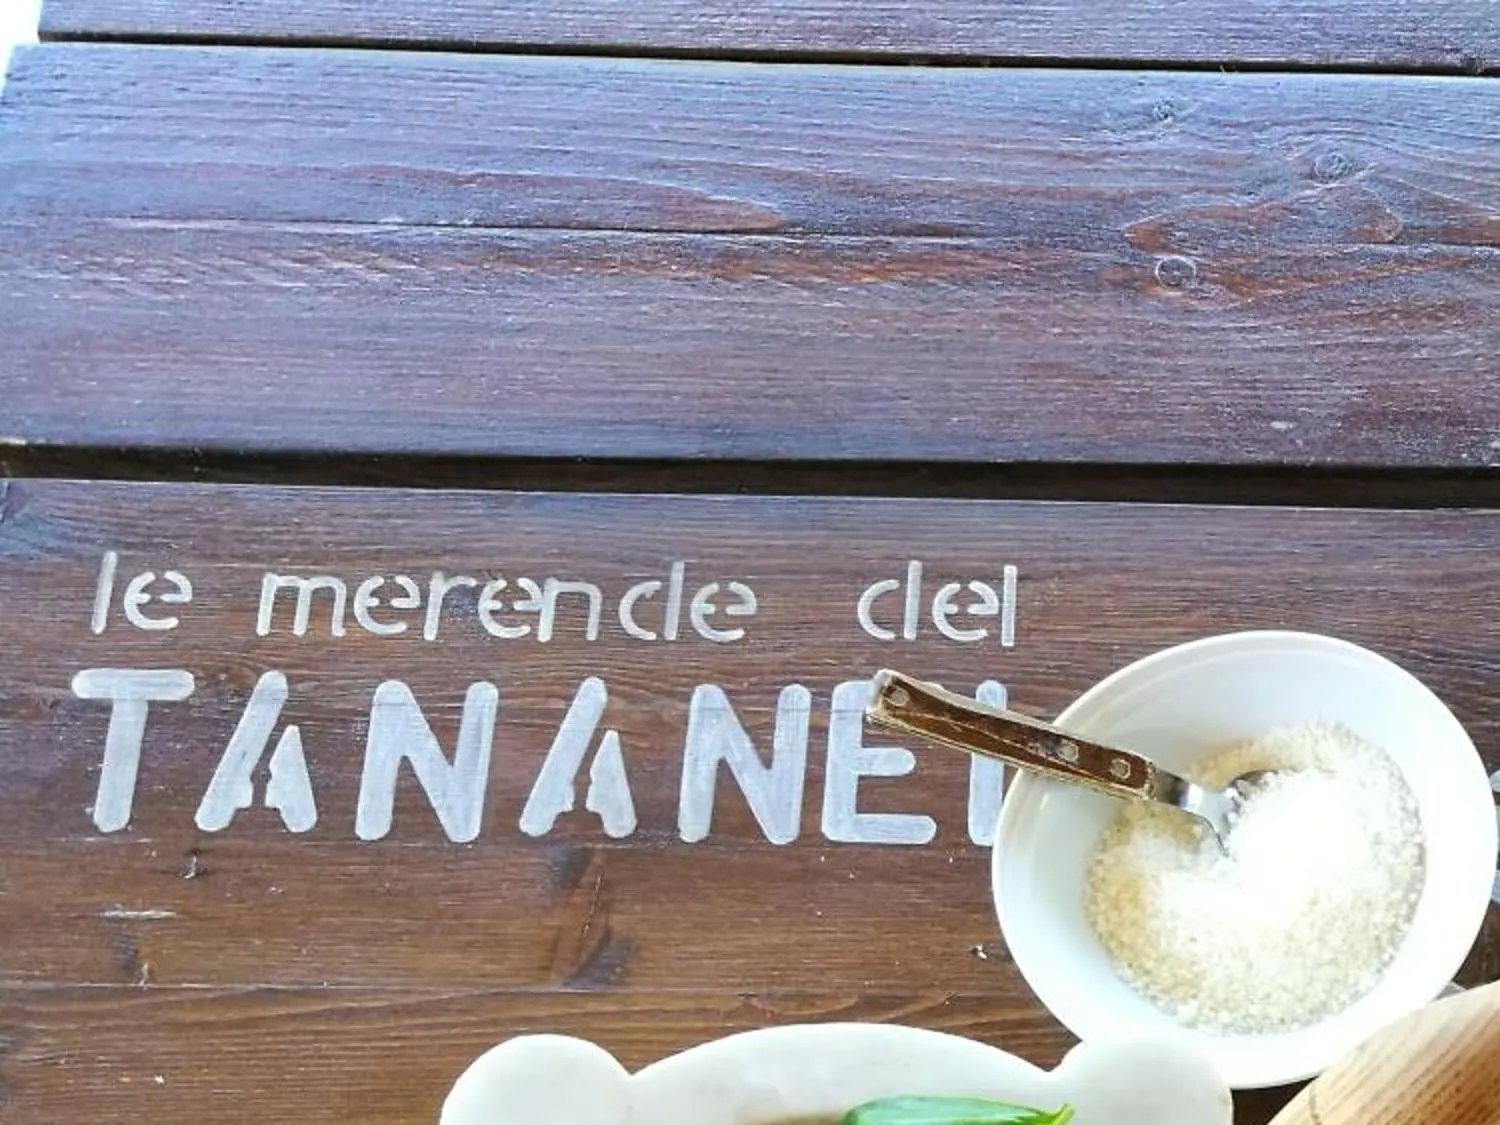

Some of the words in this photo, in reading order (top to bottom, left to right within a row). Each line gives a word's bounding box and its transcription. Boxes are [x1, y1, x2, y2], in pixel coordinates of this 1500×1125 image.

[90, 549, 194, 635] le
[254, 559, 758, 644] merende
[856, 559, 1019, 648] del
